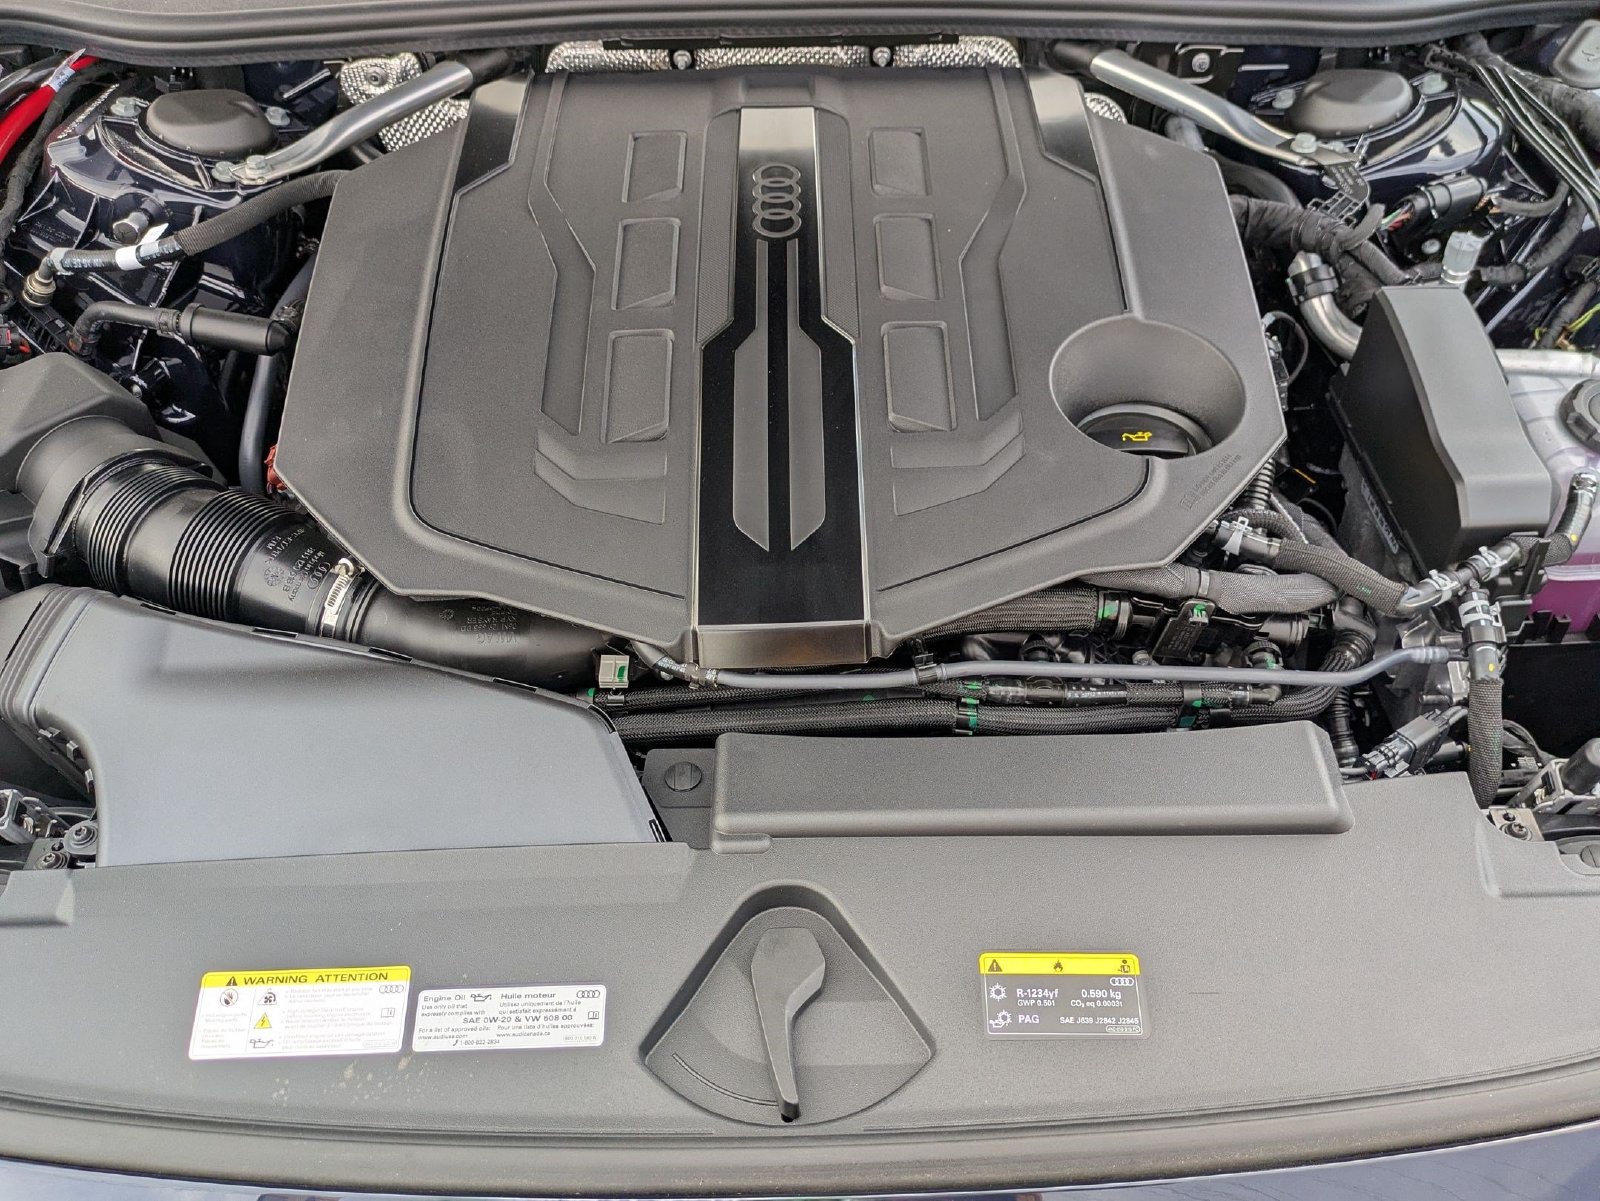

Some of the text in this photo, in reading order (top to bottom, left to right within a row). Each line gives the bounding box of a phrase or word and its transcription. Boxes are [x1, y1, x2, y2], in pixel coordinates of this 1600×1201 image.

[244, 972, 388, 986] WARNING ATTENTION
[1017, 988, 1121, 1000] R-1234yf 0.590 kg
[1019, 1015, 1040, 1024] PAG
